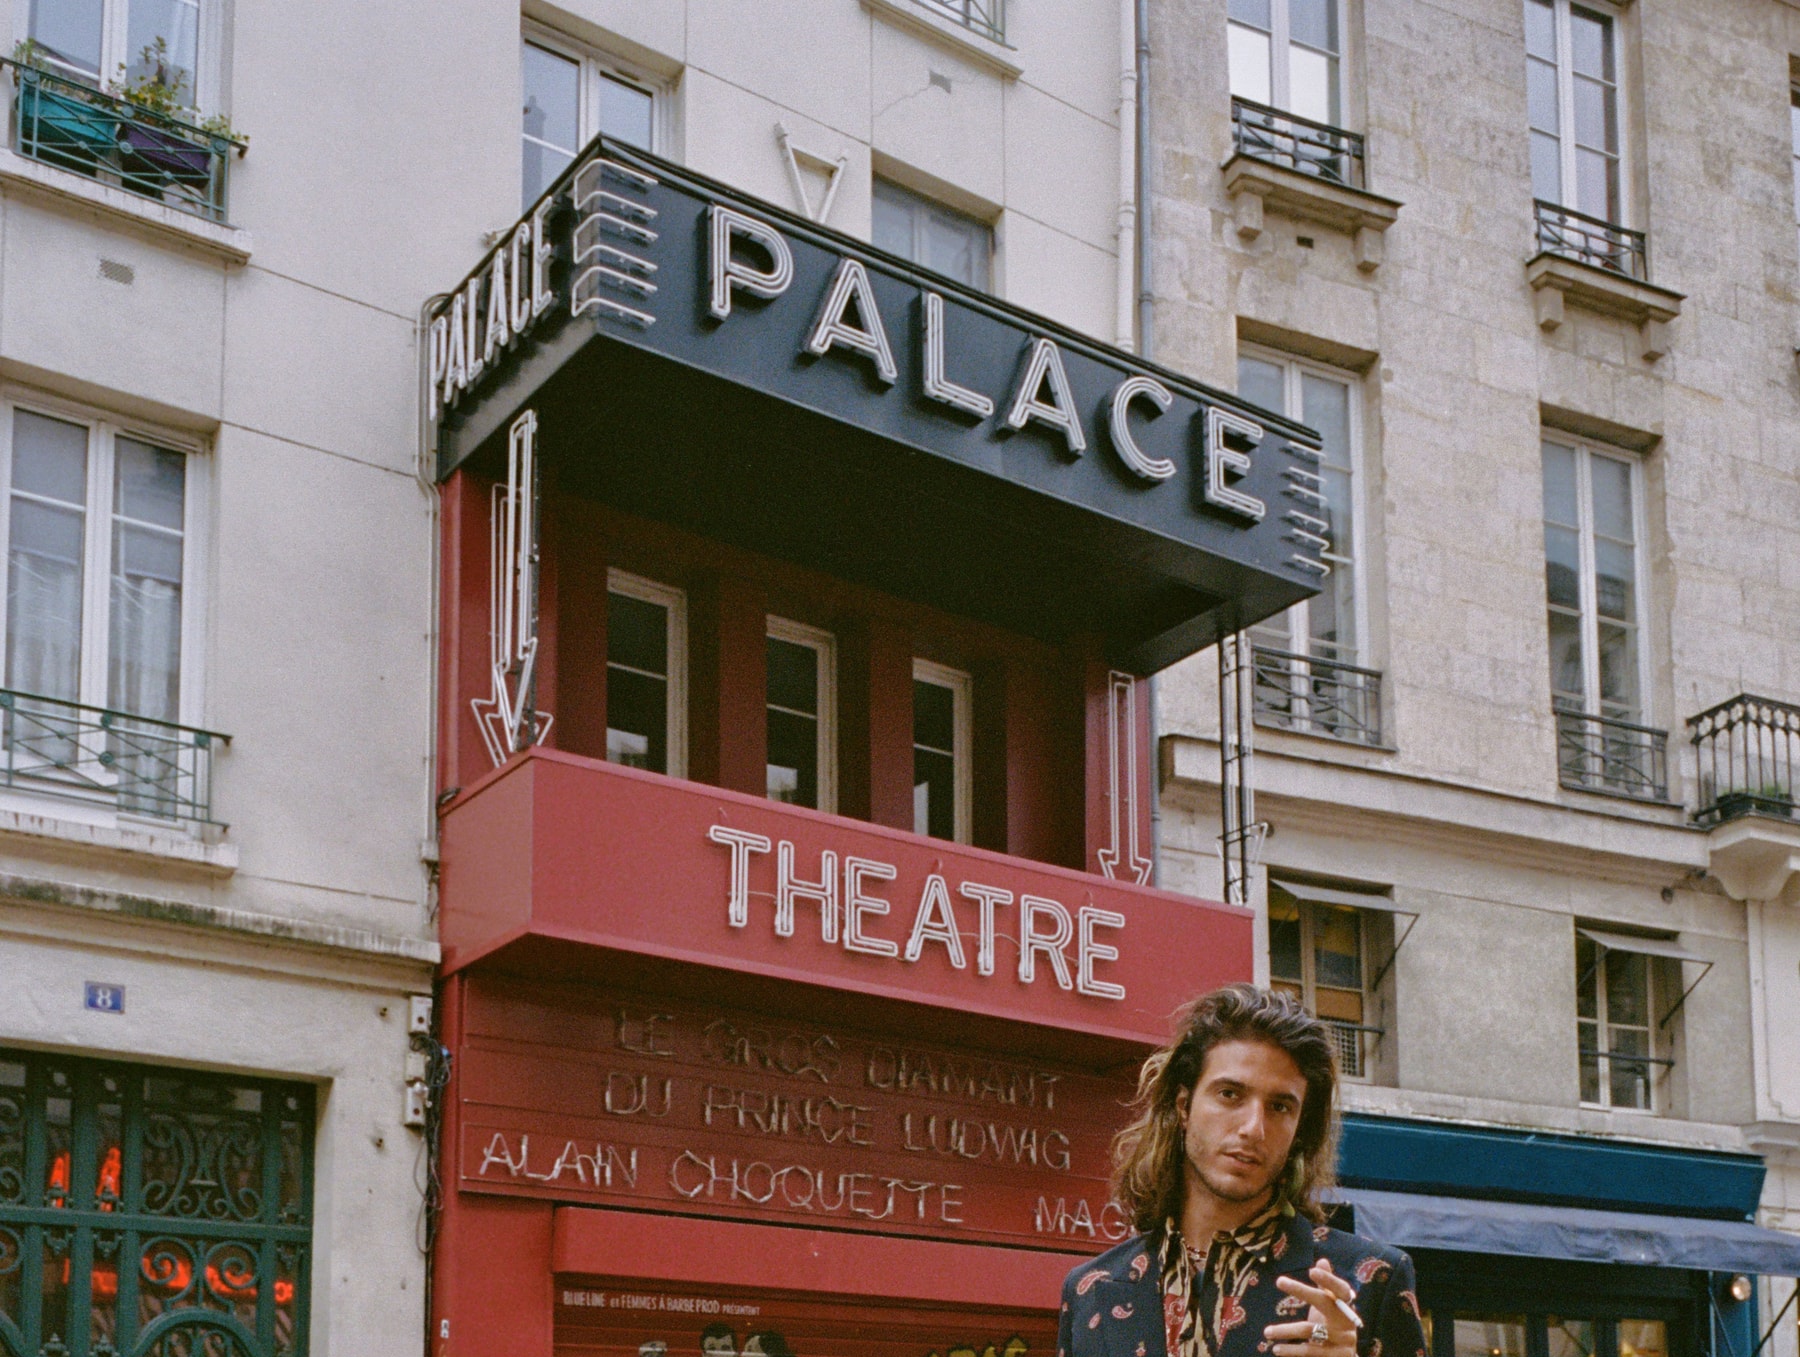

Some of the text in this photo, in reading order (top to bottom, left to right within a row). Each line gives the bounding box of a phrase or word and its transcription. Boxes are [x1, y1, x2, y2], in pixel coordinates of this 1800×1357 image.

[428, 196, 554, 421] PALACE
[708, 203, 1266, 523] PALACE
[707, 824, 1127, 1000] THEATRE
[97, 988, 112, 1009] 8
[618, 1008, 1061, 1110] LE GROS DIAMANT
[604, 1071, 1071, 1171] DU PRINCE LUDWIG
[478, 1132, 1136, 1240] ALAIN CHOQUETTE MAG
[620, 1294, 657, 1311] FEMMES
[666, 1297, 695, 1313] BARBE
[695, 1299, 720, 1314] PROD
